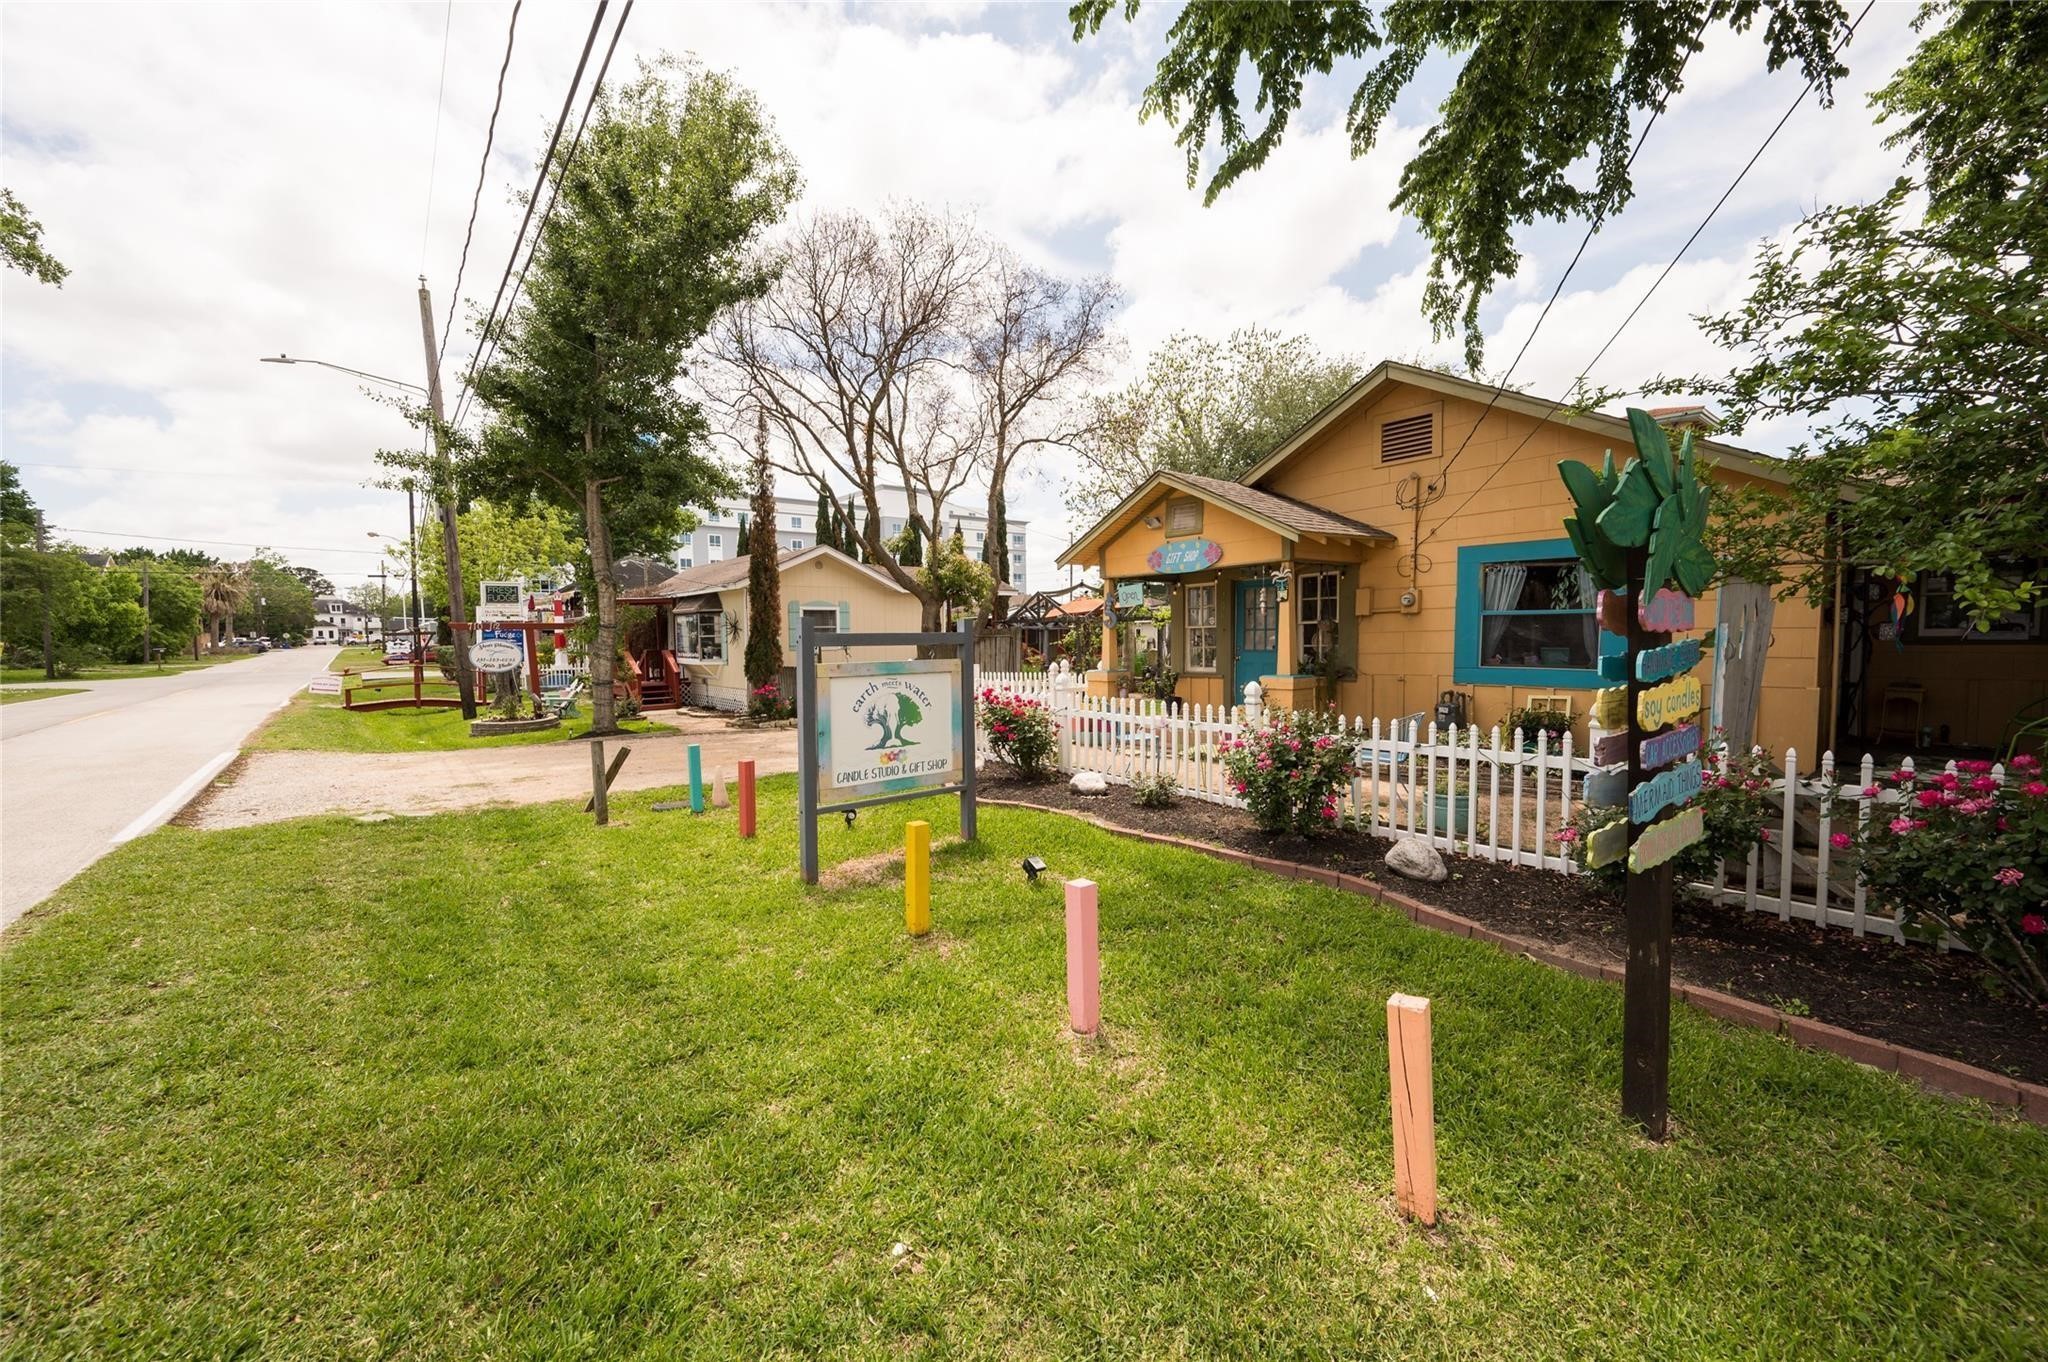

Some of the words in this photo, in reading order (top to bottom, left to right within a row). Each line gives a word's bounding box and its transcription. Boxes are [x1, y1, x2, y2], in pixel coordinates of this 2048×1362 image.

[1166, 552, 1182, 564] GIFT
[1184, 549, 1199, 562] SHOP
[487, 586, 517, 594] FRESH
[487, 594, 518, 602] FUDGE
[852, 682, 879, 713] earth
[905, 681, 932, 708] water
[1645, 699, 1662, 727] soy
[1666, 681, 1700, 712] candles
[837, 769, 869, 784] CANDLE
[871, 765, 900, 779] STUDIO
[902, 763, 907, 774] &
[909, 761, 926, 774] GIFT
[927, 758, 948, 771] SHOP
[1632, 778, 1675, 819] MERMAID
[1677, 765, 1702, 794] THINGS
